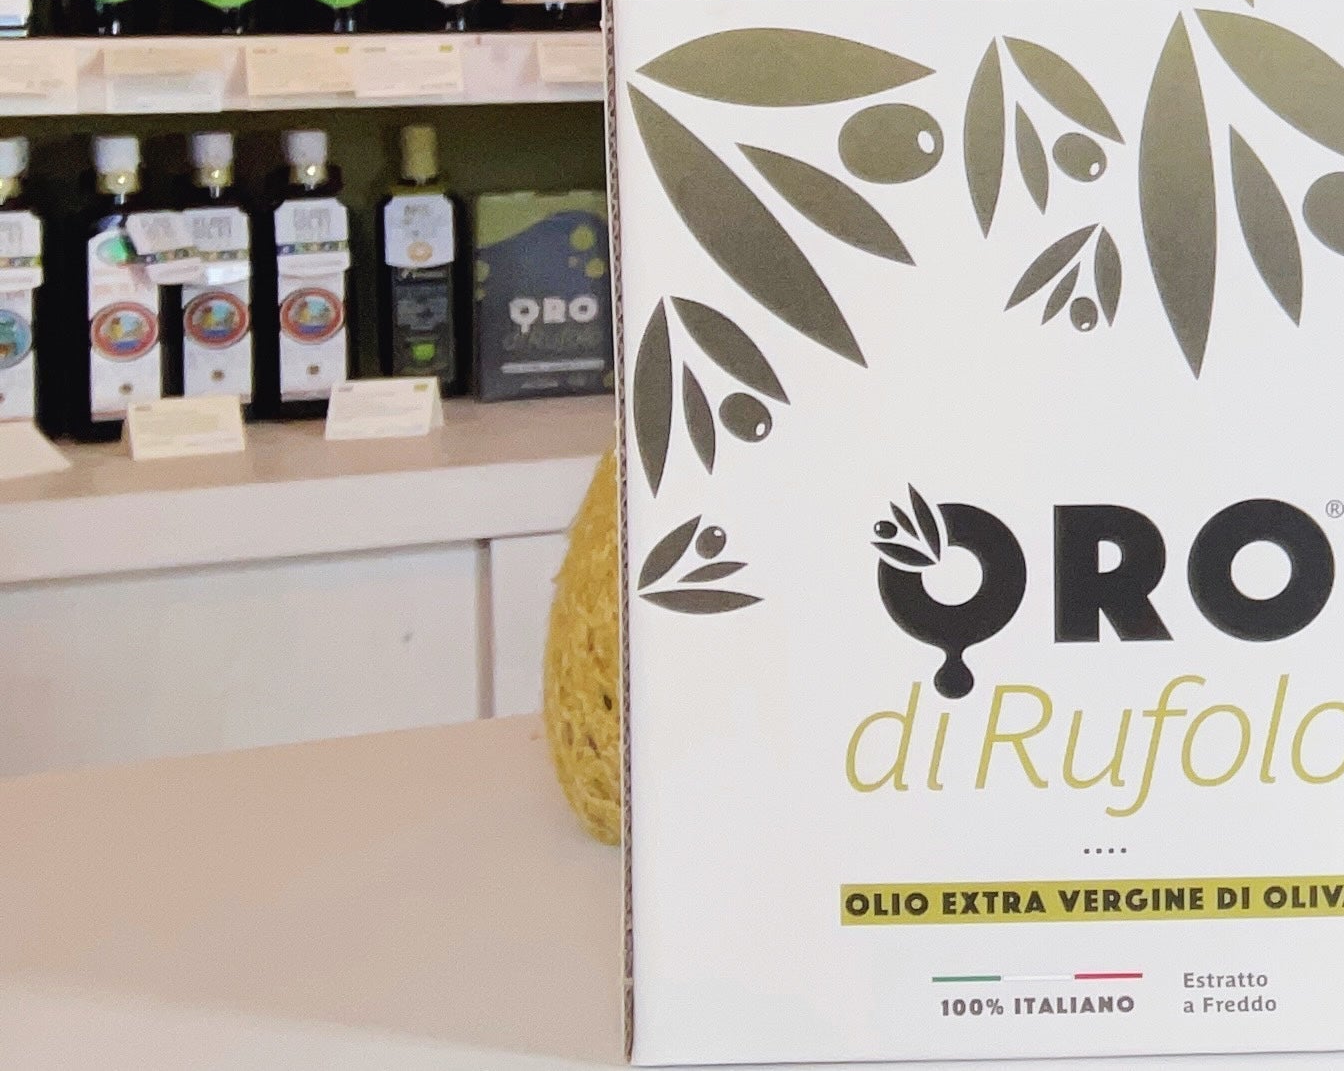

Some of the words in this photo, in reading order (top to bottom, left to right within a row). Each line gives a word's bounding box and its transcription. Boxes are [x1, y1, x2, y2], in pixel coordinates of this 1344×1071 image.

[509, 296, 598, 333] ORO
[876, 497, 1336, 698] ORO
[844, 680, 951, 793] di
[844, 891, 929, 918] OLIO
[941, 889, 1048, 916] EXTRA
[1057, 886, 1206, 914] VERGINE
[1216, 884, 1252, 912] DI
[1181, 971, 1269, 990] Estratto
[939, 997, 1006, 1018] 100%
[1013, 994, 1137, 1016] ITALIANO
[1182, 1001, 1196, 1015] a
[1201, 994, 1278, 1015] Freddo
